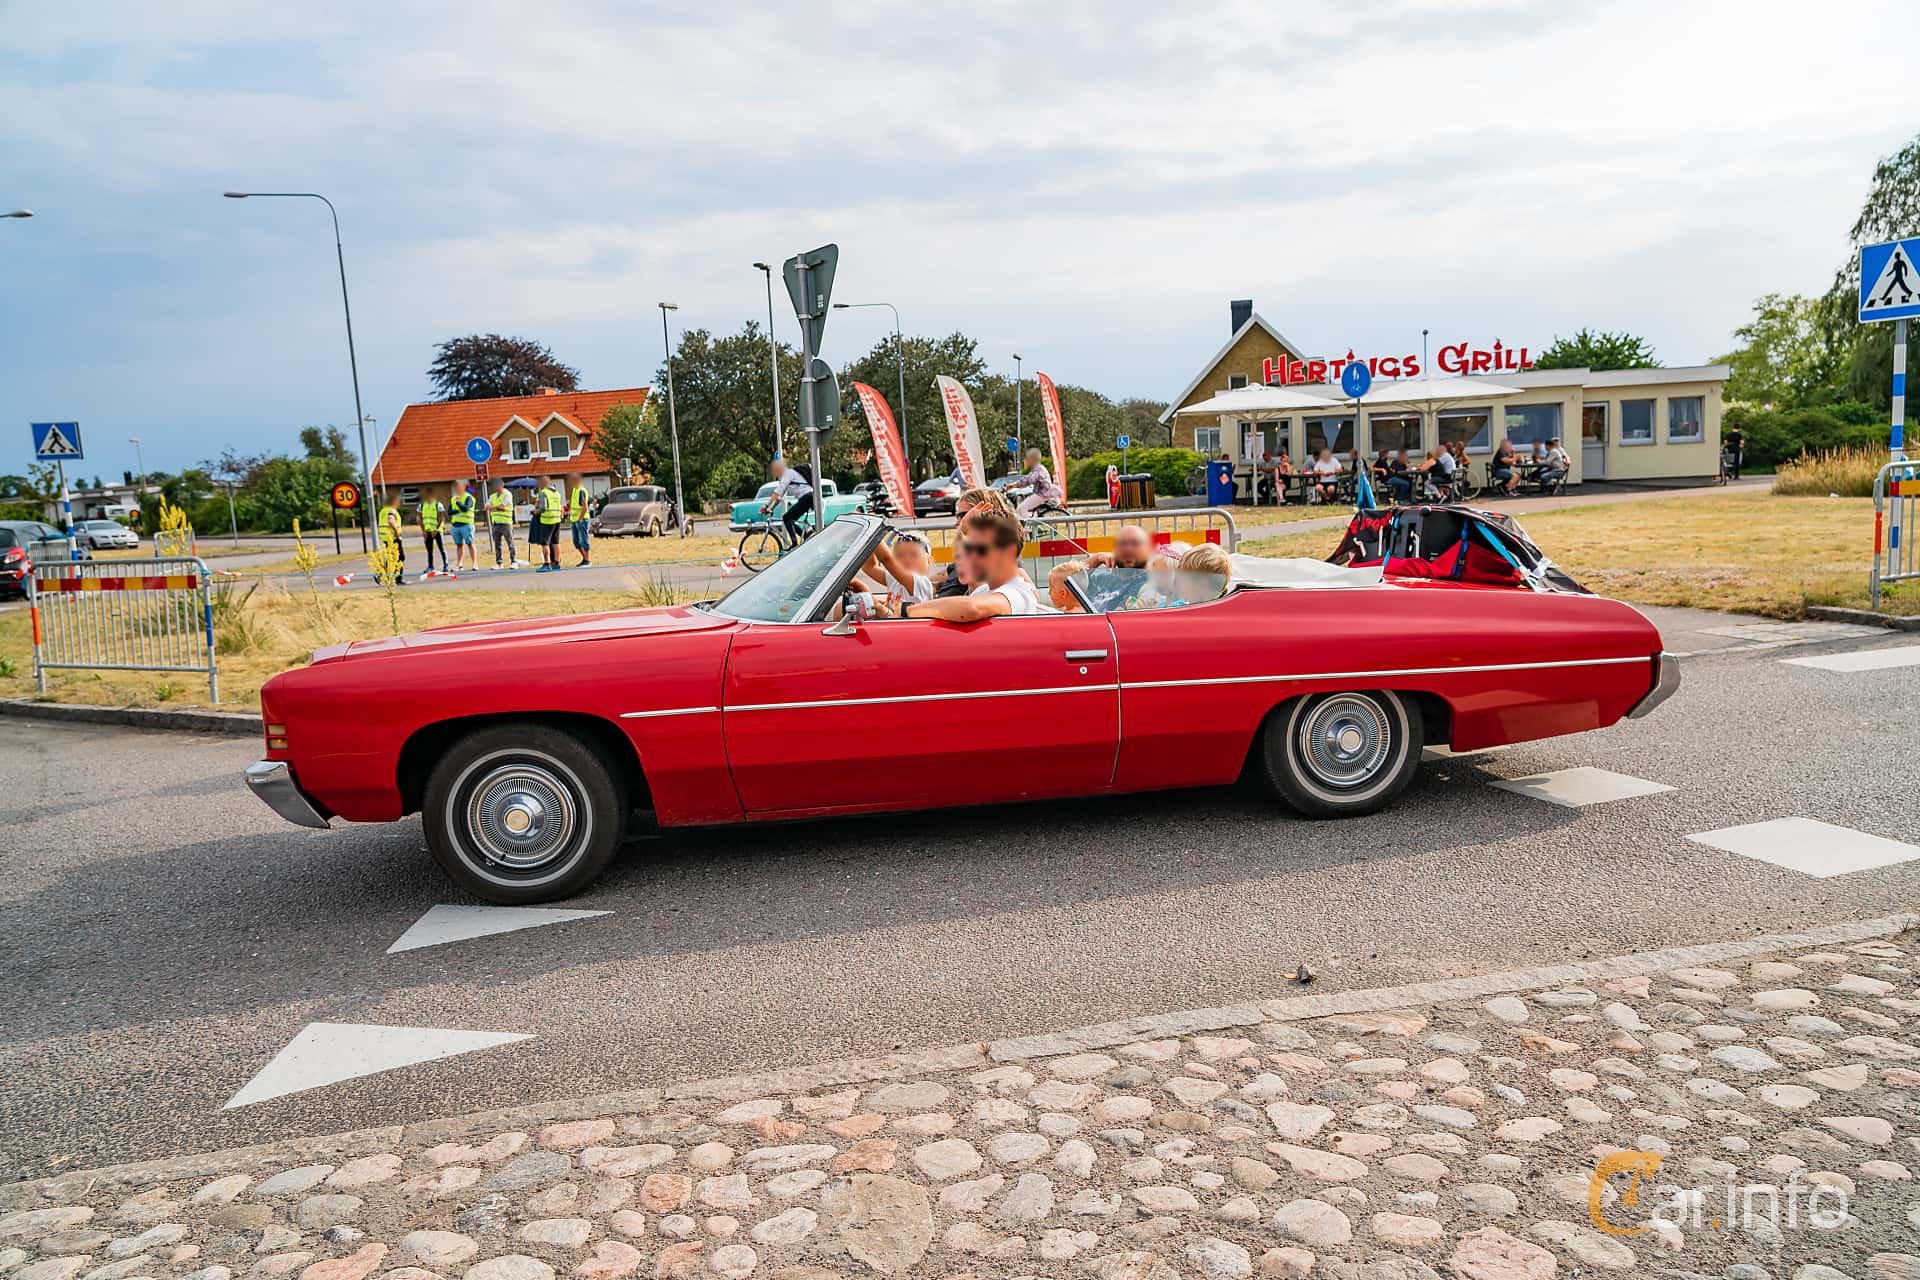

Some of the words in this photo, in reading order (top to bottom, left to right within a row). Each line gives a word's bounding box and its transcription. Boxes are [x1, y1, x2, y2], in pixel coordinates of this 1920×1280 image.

[1263, 350, 1420, 385] HERTGS
[1437, 339, 1533, 376] GRILL
[337, 490, 353, 501] 30
